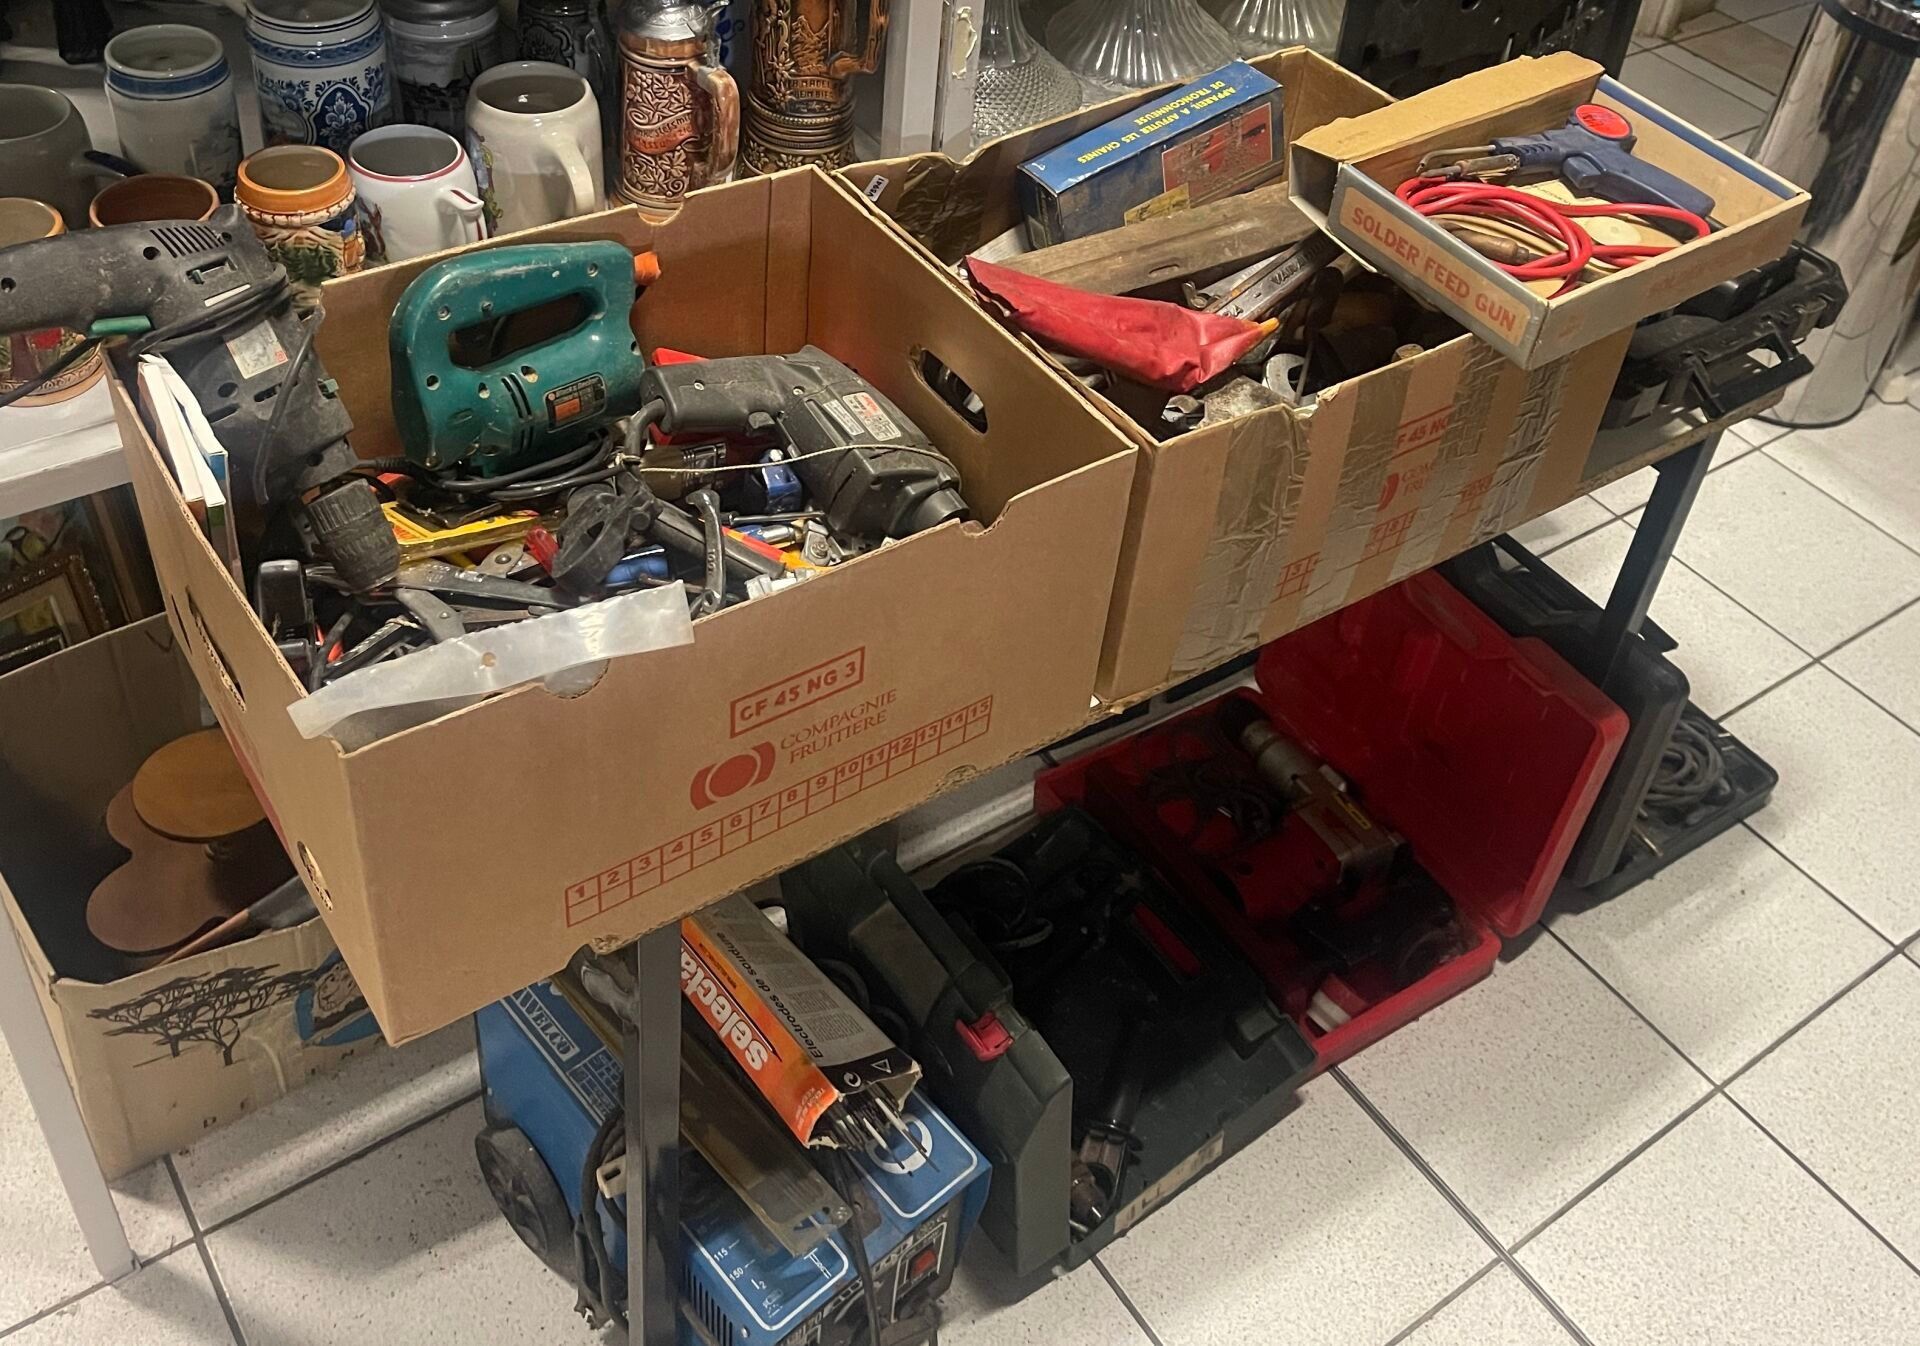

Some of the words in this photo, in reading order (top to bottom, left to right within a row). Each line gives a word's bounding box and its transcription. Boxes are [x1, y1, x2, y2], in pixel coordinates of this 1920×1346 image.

[1191, 87, 1236, 110] APPAREIL
[1210, 80, 1226, 90] DE
[1133, 88, 1212, 126] TRONCONNEUSE
[1181, 107, 1192, 116] A
[1121, 132, 1140, 144] LES
[1140, 112, 1180, 134] AFFUTER
[1076, 141, 1121, 164] CHAINES
[1352, 207, 1420, 266] SOLDER
[1424, 257, 1470, 298] FEED
[1475, 293, 1517, 331] GUN
[740, 699, 768, 721] CF
[774, 685, 800, 707] 45
[807, 669, 838, 694] NG
[845, 661, 857, 677] 3
[780, 688, 897, 750] COMPAGNIE
[789, 709, 888, 764] FRUITIERE
[574, 884, 585, 898] 1
[607, 870, 620, 886] 2
[638, 857, 651, 870] 3
[671, 841, 684, 853] 4
[700, 827, 713, 842] 5
[730, 814, 743, 828] 6
[758, 800, 771, 815] 7
[786, 789, 798, 802] 8
[815, 775, 828, 789] 9
[837, 760, 859, 778] 10
[866, 749, 885, 765] 11
[891, 737, 913, 754] 12
[917, 725, 938, 741] 13
[944, 714, 963, 729] 14
[969, 700, 989, 718] 15
[716, 932, 757, 976] soudure
[755, 977, 771, 993] de
[681, 948, 769, 1071] selecta
[769, 994, 823, 1059] Electrodes
[713, 1247, 729, 1262] 115
[729, 1266, 745, 1281] 150
